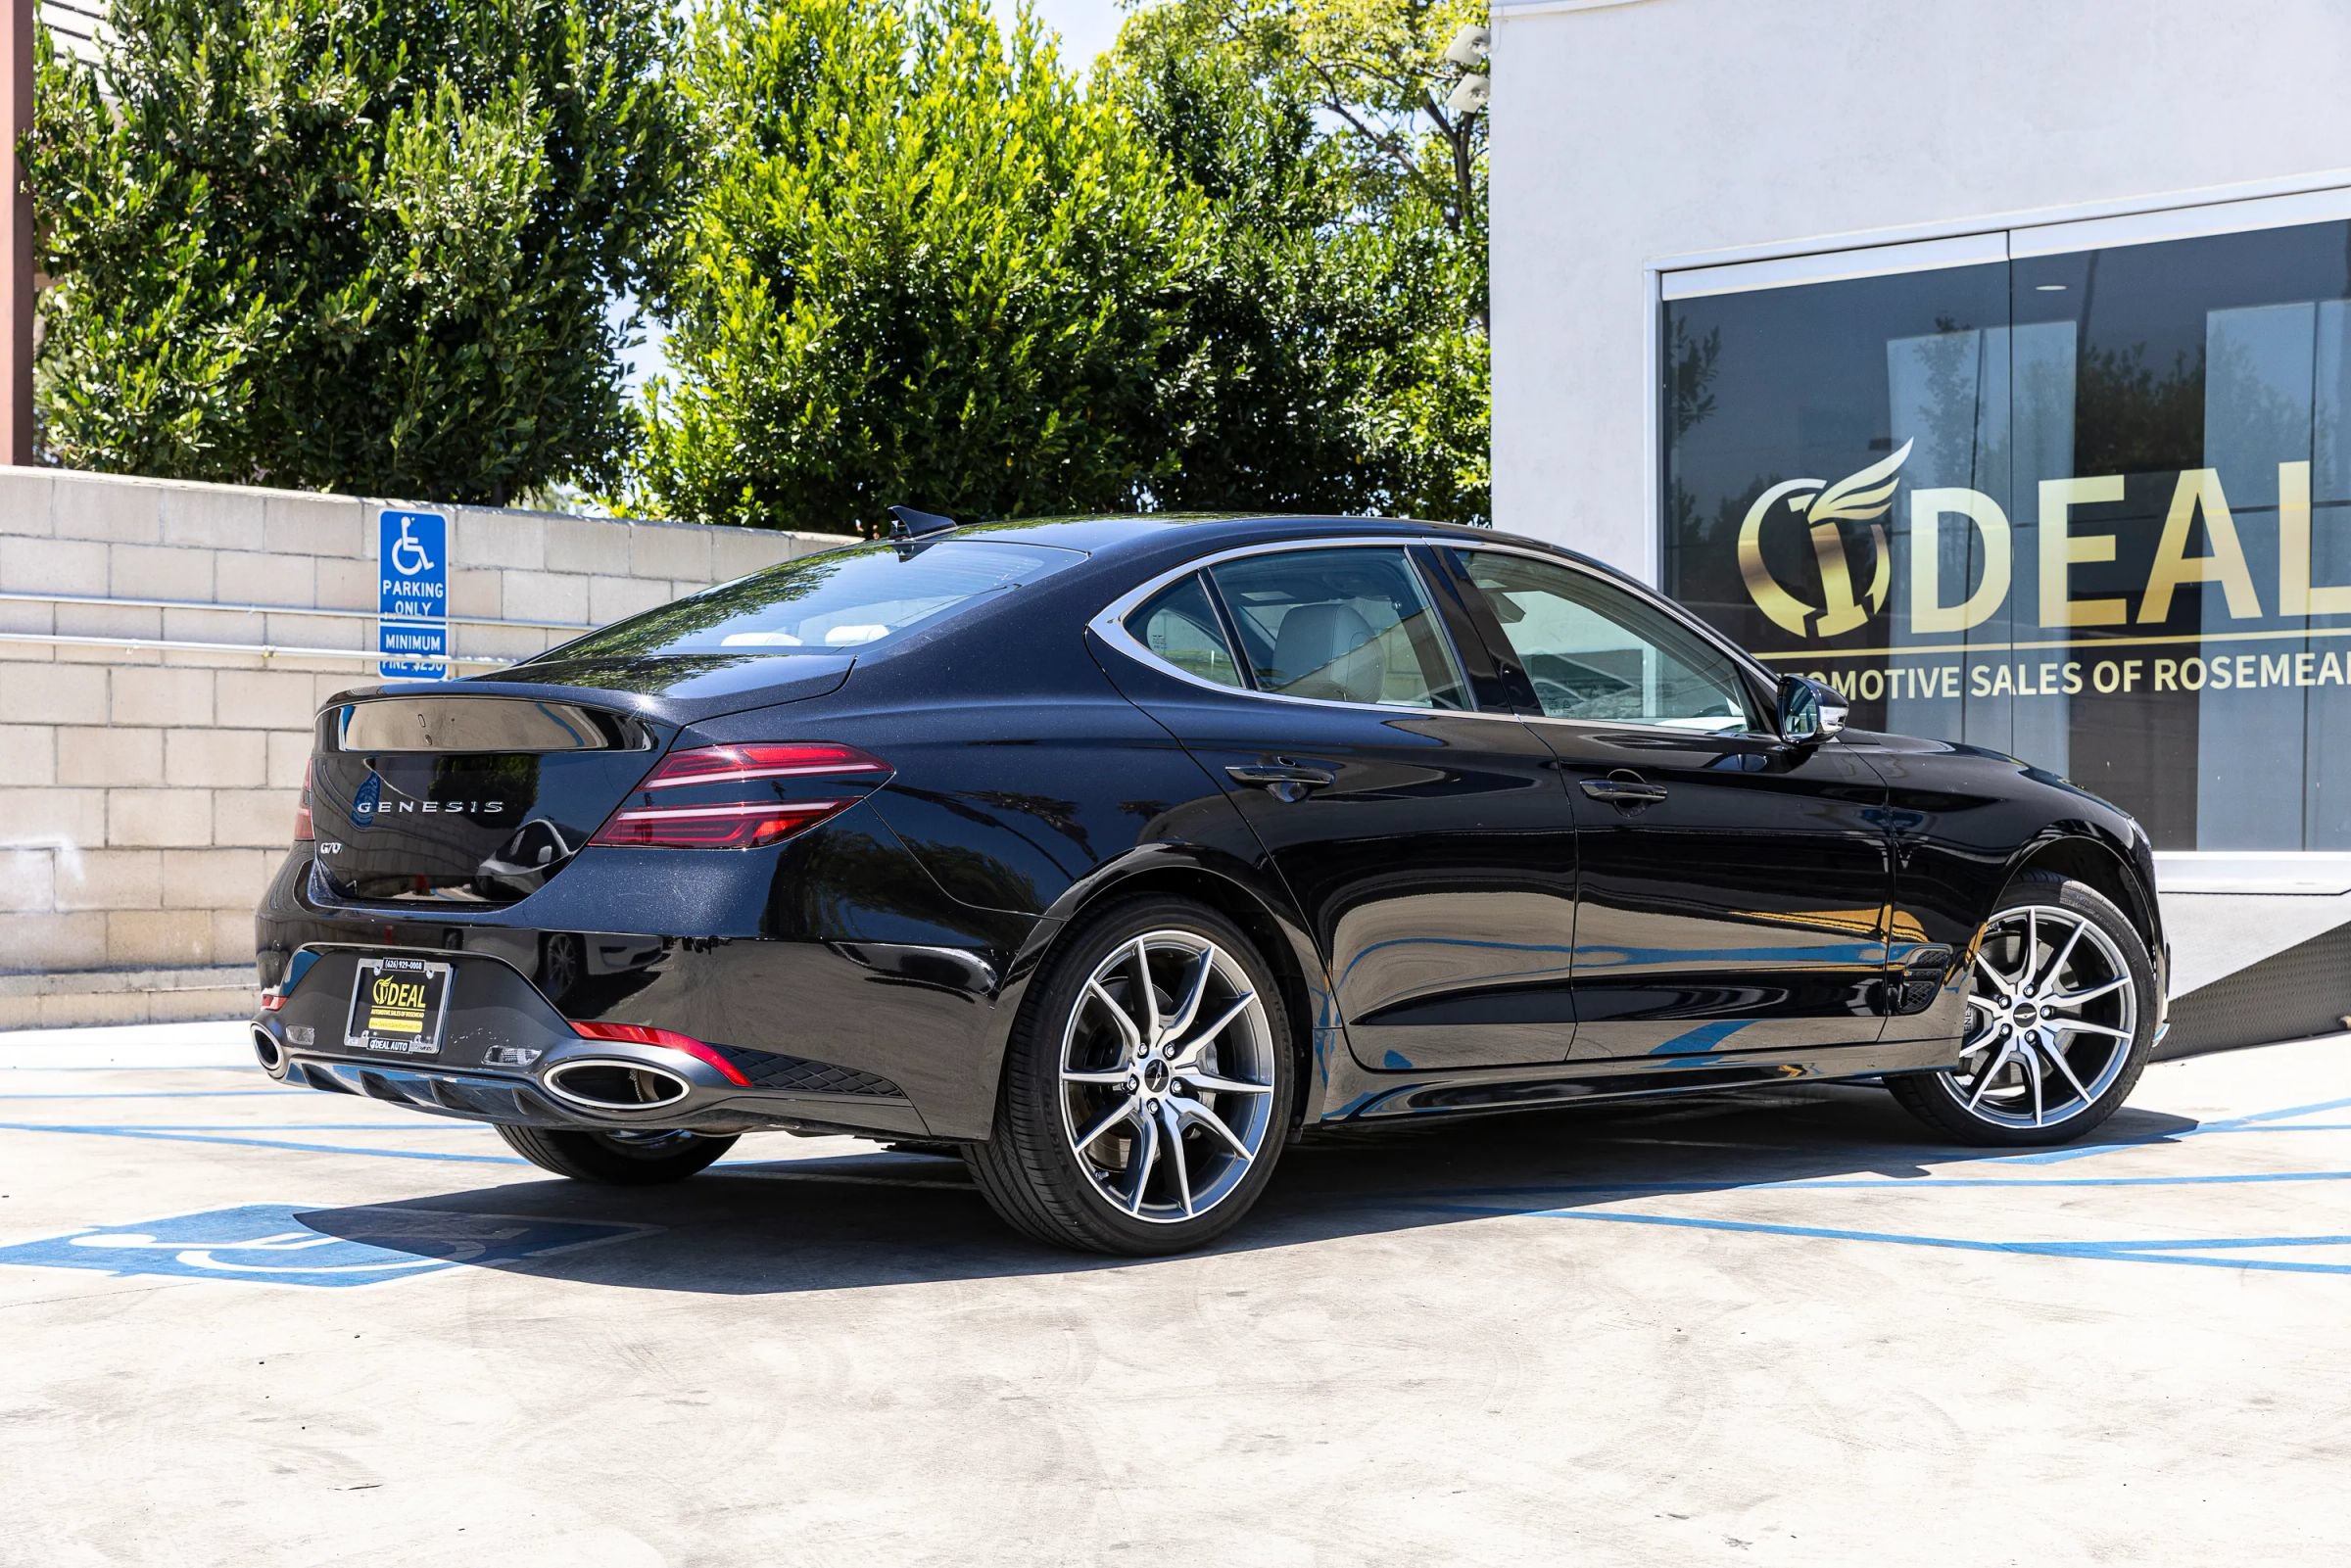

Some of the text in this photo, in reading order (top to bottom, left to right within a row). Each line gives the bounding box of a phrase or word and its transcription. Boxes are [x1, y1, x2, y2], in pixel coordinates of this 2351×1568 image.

[383, 579, 444, 598] PARKING
[395, 600, 432, 617] ONLY
[385, 634, 441, 651] MINIMUM
[1971, 662, 2083, 697] SALES
[2092, 659, 2143, 693] OF
[2154, 650, 2351, 692] ROSEMEA
[357, 801, 504, 814] GENESIS
[320, 842, 343, 854] G70
[391, 1041, 408, 1051] AUTO
